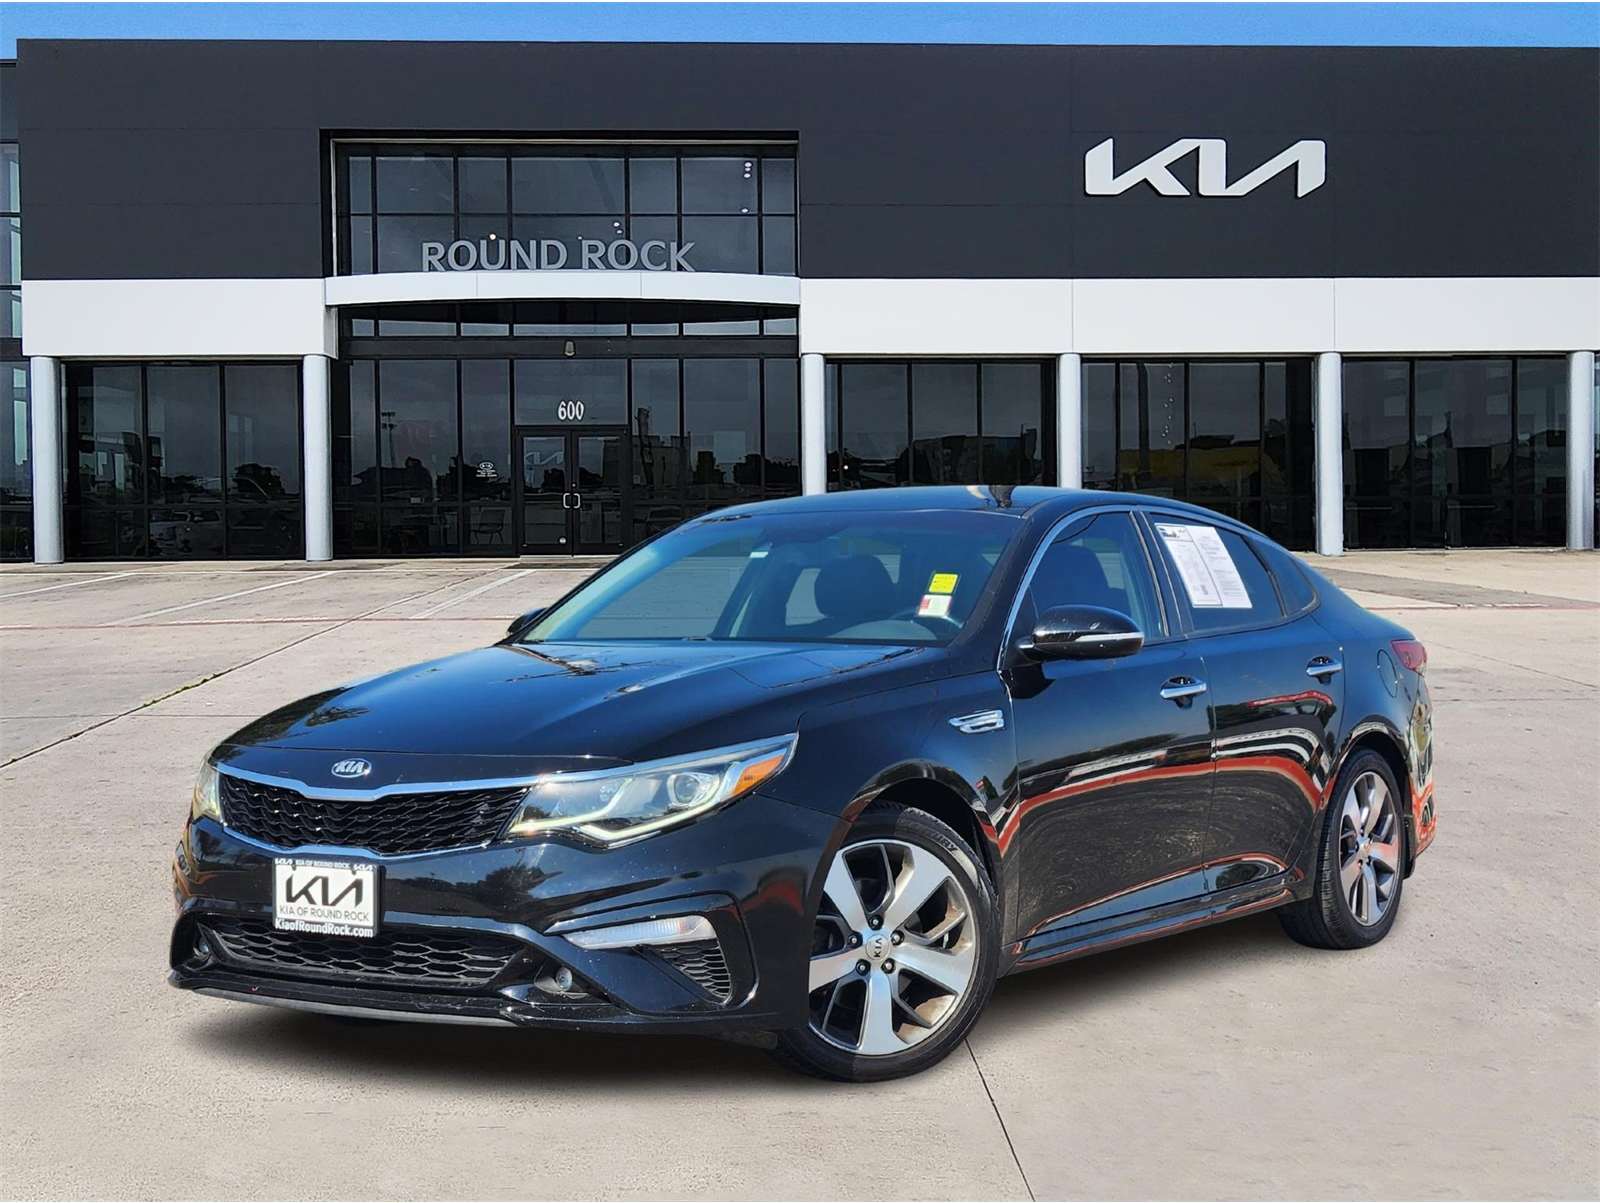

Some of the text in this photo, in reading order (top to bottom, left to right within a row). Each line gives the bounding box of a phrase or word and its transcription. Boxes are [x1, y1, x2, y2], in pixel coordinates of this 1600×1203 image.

[1085, 138, 1326, 198] KIA
[422, 239, 696, 272] ROUND ROCK
[558, 400, 584, 420] 600
[335, 760, 365, 773] KIA
[286, 875, 363, 908] KIA
[280, 905, 369, 921] KIA OF ROUND ROCK
[275, 918, 374, 938] KiaofRoundRock.com
[874, 938, 882, 957] KIA
